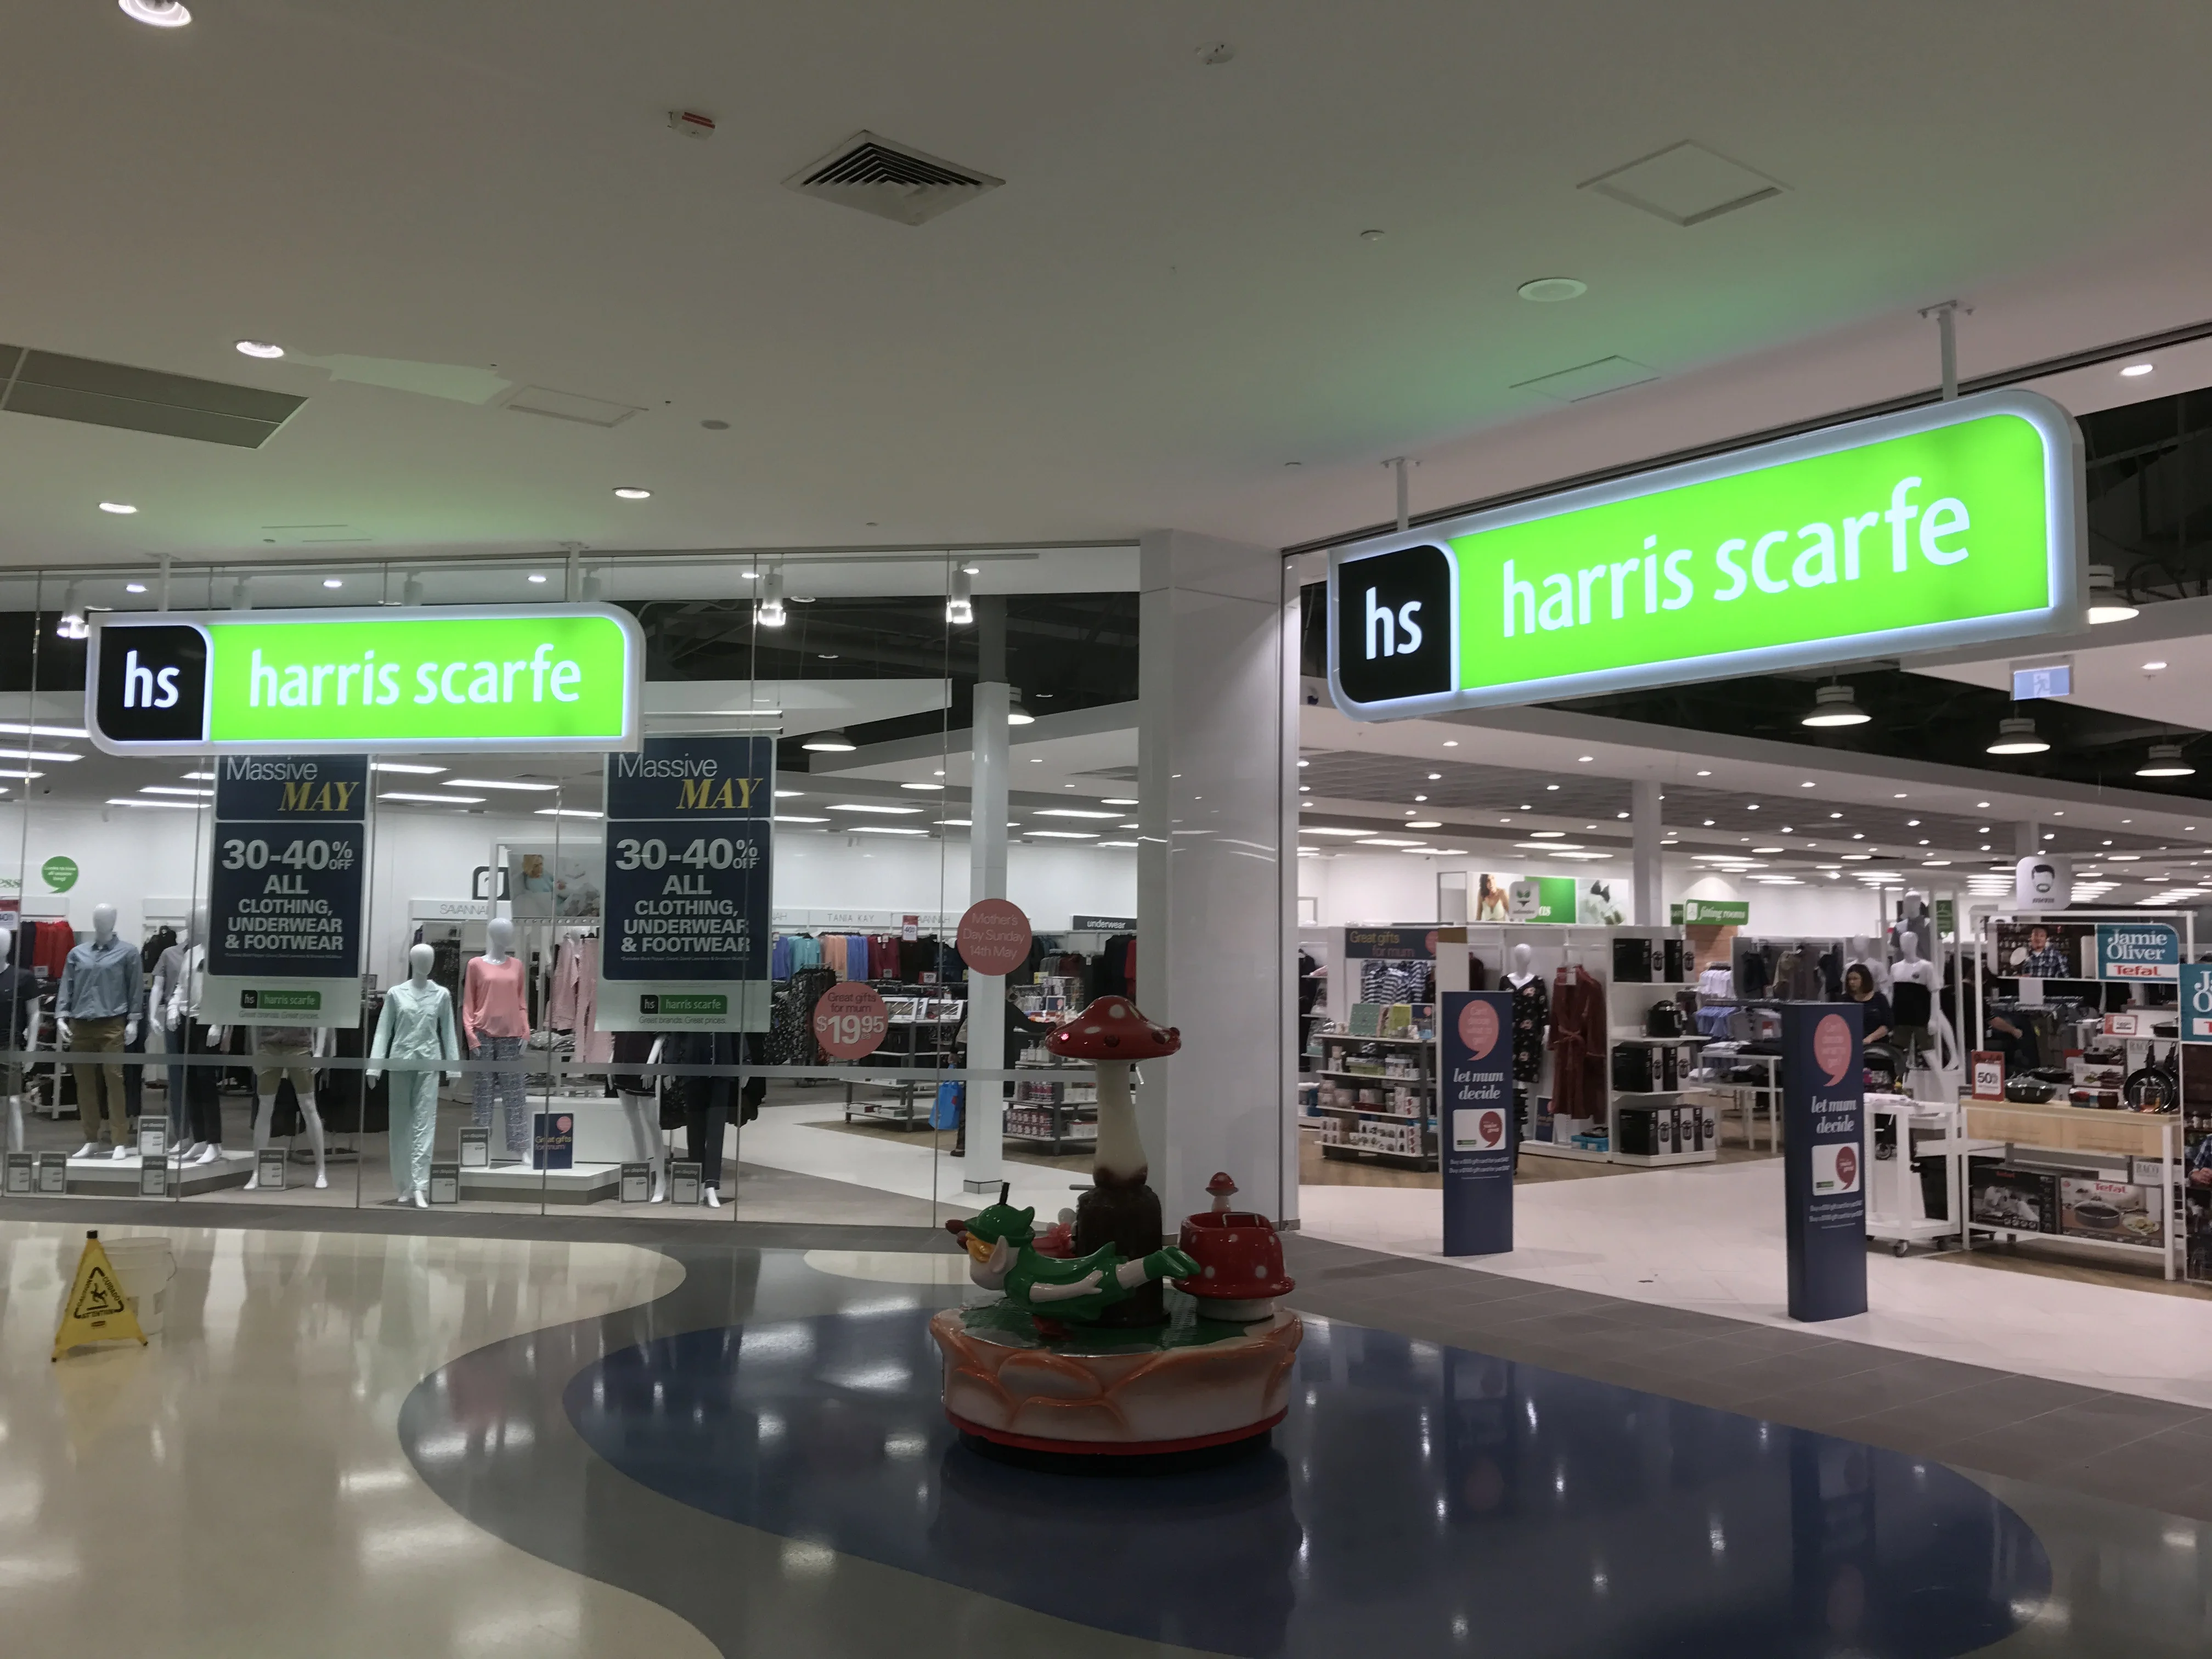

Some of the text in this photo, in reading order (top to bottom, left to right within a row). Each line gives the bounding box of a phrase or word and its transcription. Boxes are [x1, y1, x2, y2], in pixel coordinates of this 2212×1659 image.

[1503, 476, 1971, 637] harris scarfe
[1366, 586, 1423, 660] hs
[123, 650, 180, 708] hs
[250, 643, 582, 707] harris scarfe
[227, 756, 318, 780] Massive
[618, 753, 718, 777] Massive
[277, 782, 360, 811] MAY
[676, 778, 763, 809] MAY
[329, 859, 354, 870] OFF
[263, 874, 309, 894] ALL
[662, 874, 712, 895] ALL
[238, 899, 334, 916] CLOTHING,
[635, 900, 738, 917] CLOTHING,
[228, 917, 343, 933] UNDERWEAR
[827, 913, 874, 923] TANIA KAY
[972, 913, 1019, 926] Mother's
[1086, 919, 1126, 929] underwear
[624, 919, 749, 934] UNDERWEAR
[224, 935, 343, 950] & FOOTWEAR
[963, 928, 1025, 944] Day Sunday
[1350, 931, 1400, 946] Great gifts
[2108, 929, 2168, 946] Jamie
[621, 937, 750, 952] & FOOTWEAR
[1373, 944, 1415, 957] for mum
[2107, 944, 2165, 960] Oliver
[969, 945, 1018, 960] 14th May
[2114, 965, 2162, 977] Tefal
[244, 994, 255, 1004] hs
[264, 994, 315, 1005] harris scarfe
[644, 998, 655, 1009] hs
[665, 998, 721, 1009] harris scarfe
[828, 992, 876, 1004] Great gifts
[831, 1003, 843, 1012] for
[1453, 1068, 1504, 1083] let mum
[1458, 1084, 1502, 1100] decide
[1811, 1096, 1857, 1113] let mum
[1816, 1114, 1855, 1134] decide
[2094, 1182, 2126, 1193] Tefal
